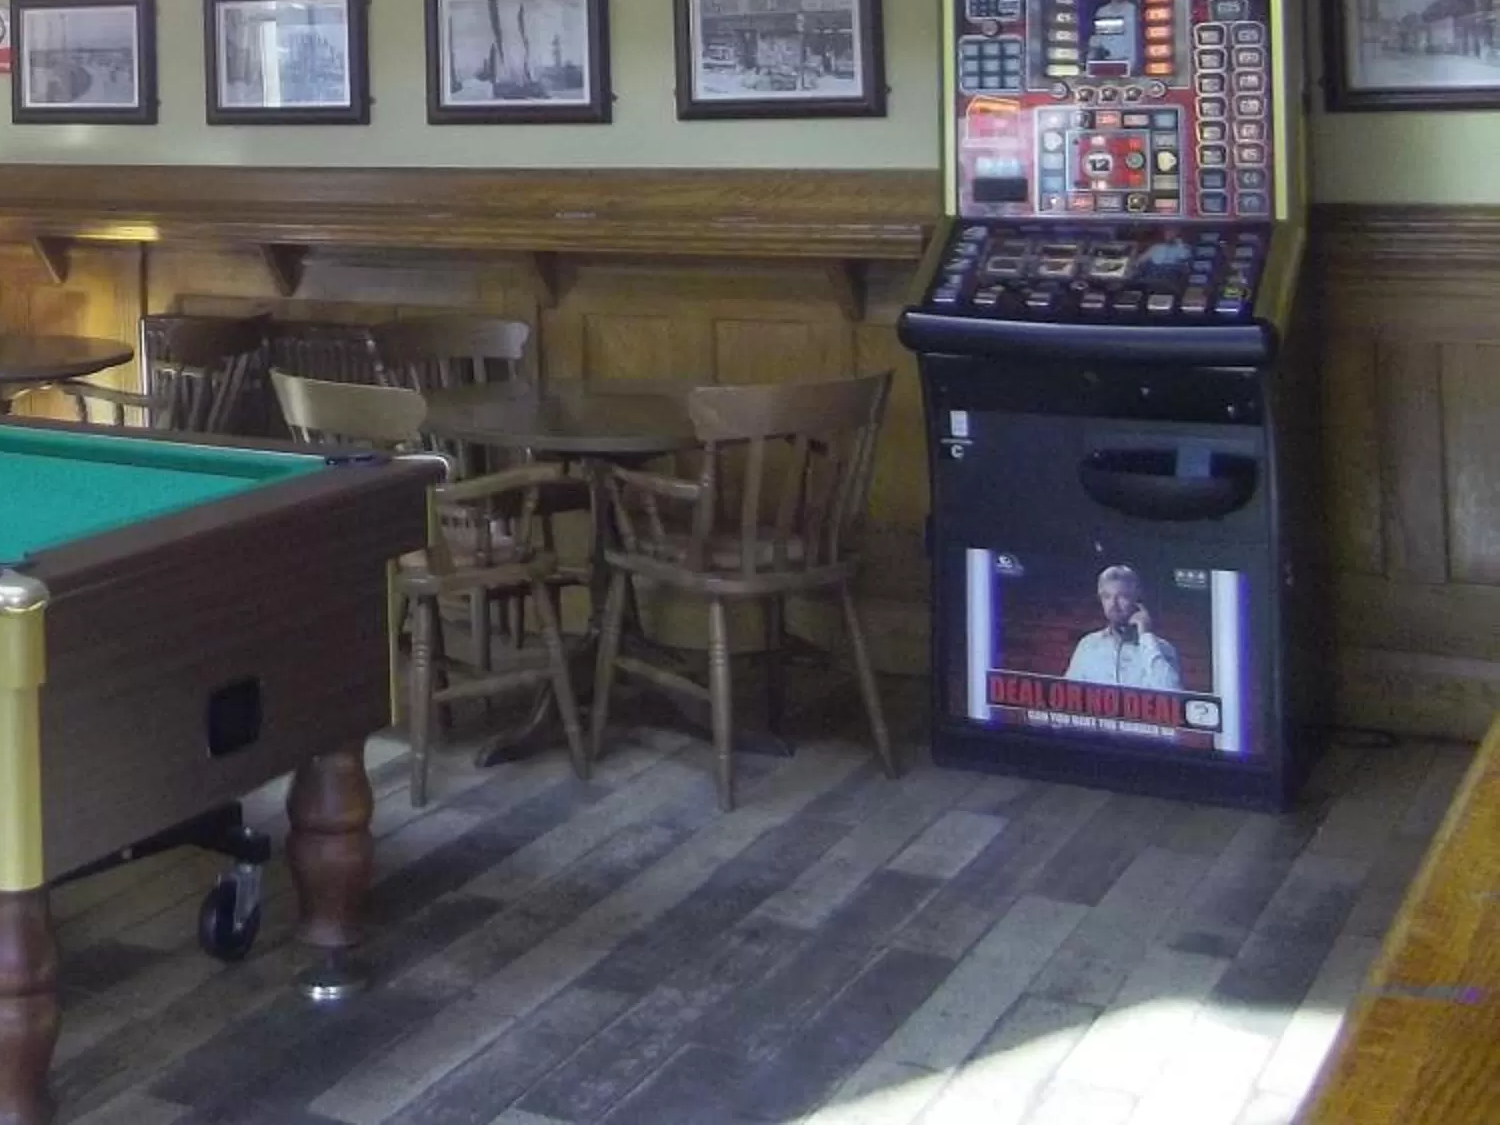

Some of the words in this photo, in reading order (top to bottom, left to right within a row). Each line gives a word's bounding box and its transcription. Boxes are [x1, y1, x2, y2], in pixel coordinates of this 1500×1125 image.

[1089, 158, 1111, 172] 12
[990, 674, 1044, 709] DEAL
[1049, 682, 1085, 711] OR
[1086, 687, 1120, 715] NO
[1123, 692, 1184, 726] DEAL
